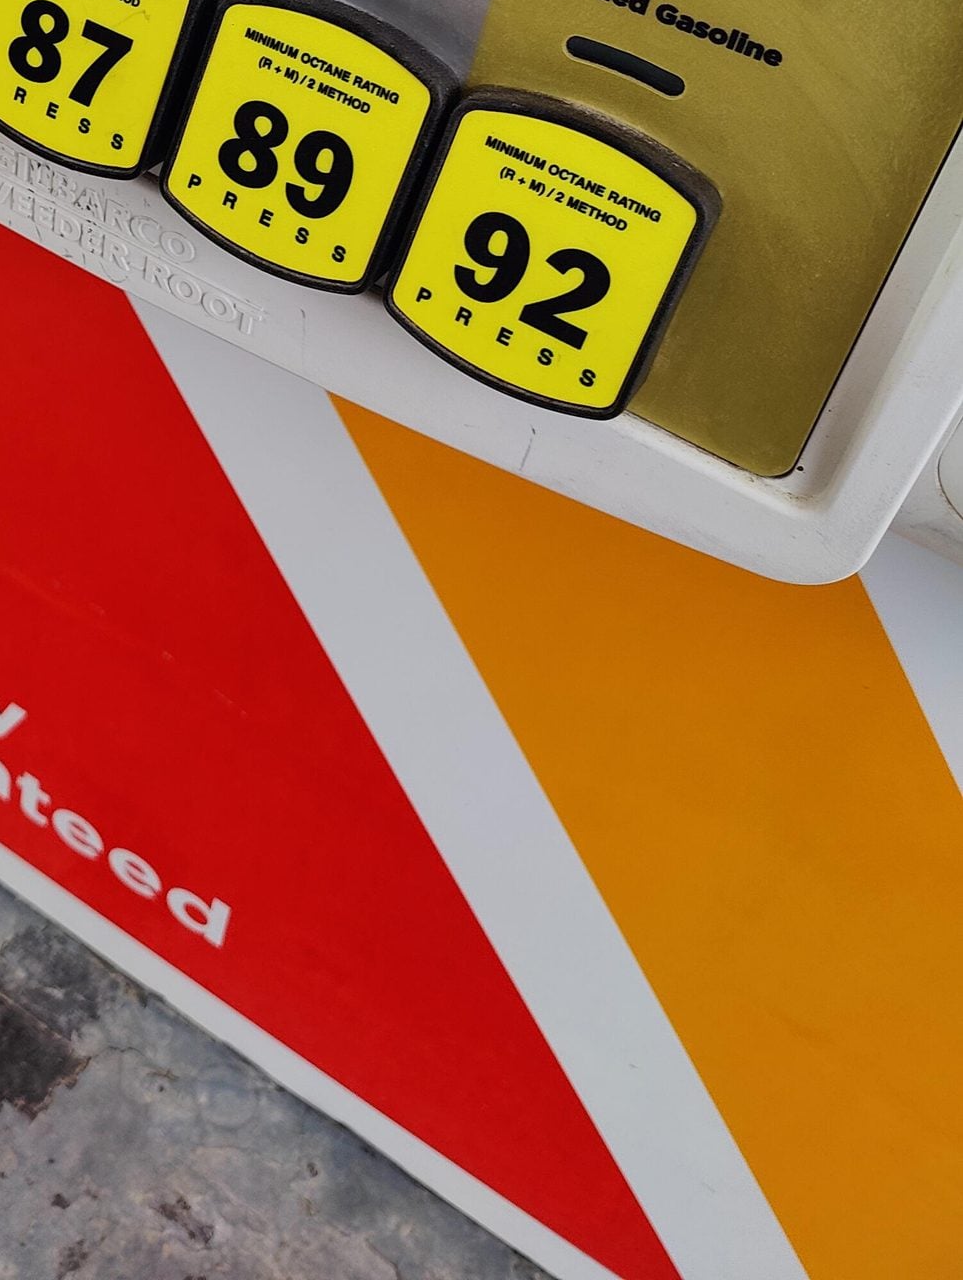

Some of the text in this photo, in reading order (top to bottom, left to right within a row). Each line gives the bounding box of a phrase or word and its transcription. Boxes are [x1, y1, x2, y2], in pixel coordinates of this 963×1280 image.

[8, 0, 134, 108] 87
[244, 27, 400, 105] MINIMUM OCTANE RATING
[655, 4, 783, 67] Gasoline
[317, 82, 371, 114] METHOD
[218, 100, 354, 220] 89
[485, 136, 662, 223] MINIMUM OCTANE RATING
[566, 196, 628, 232] METHOD
[454, 211, 611, 350] 92
